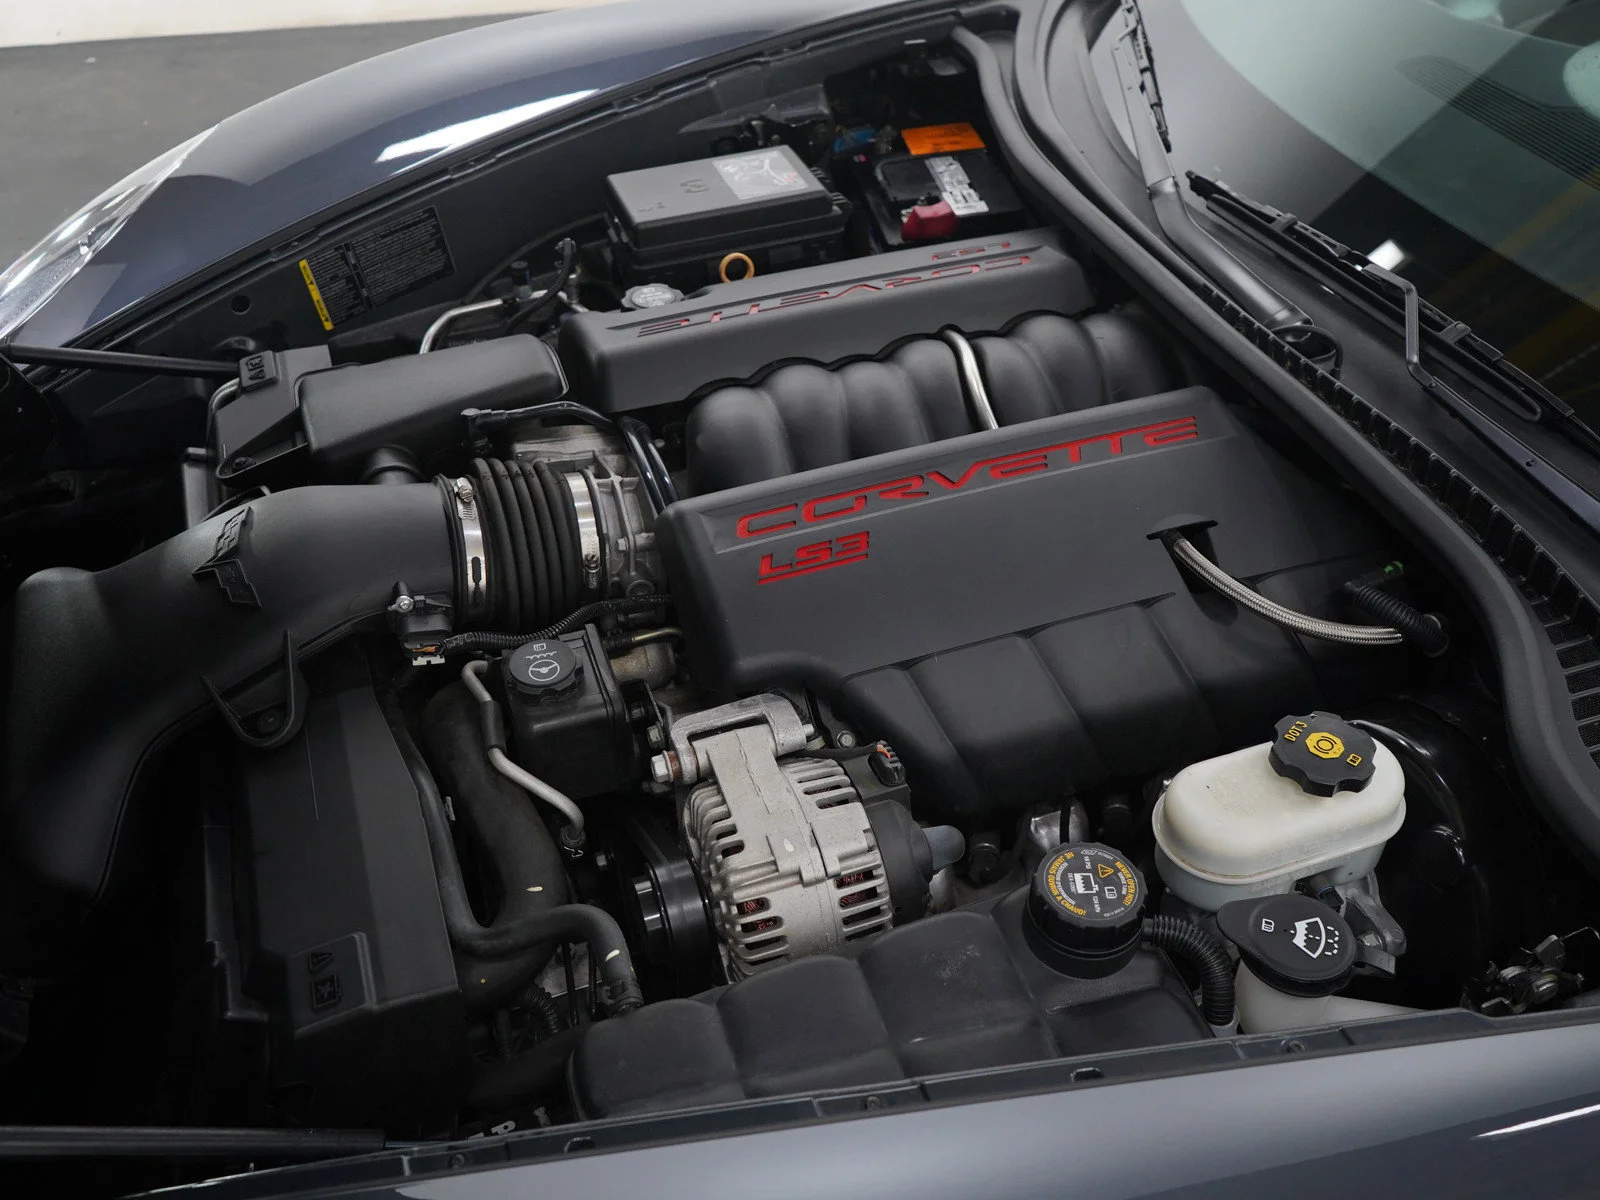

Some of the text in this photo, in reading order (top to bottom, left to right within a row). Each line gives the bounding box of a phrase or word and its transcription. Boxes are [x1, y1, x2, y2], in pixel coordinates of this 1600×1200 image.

[637, 256, 1031, 337] CORVETTE
[736, 416, 1198, 539] CORVETTE
[757, 531, 870, 578] LS3
[1284, 724, 1303, 742] DOT
[1049, 856, 1065, 874] JAMAIS
[1063, 851, 1075, 859] NE
[1048, 875, 1059, 896] OUVRIR
[1115, 861, 1136, 906] NEVER OPEN HOT!
[1061, 900, 1086, 916] CHAUD!
